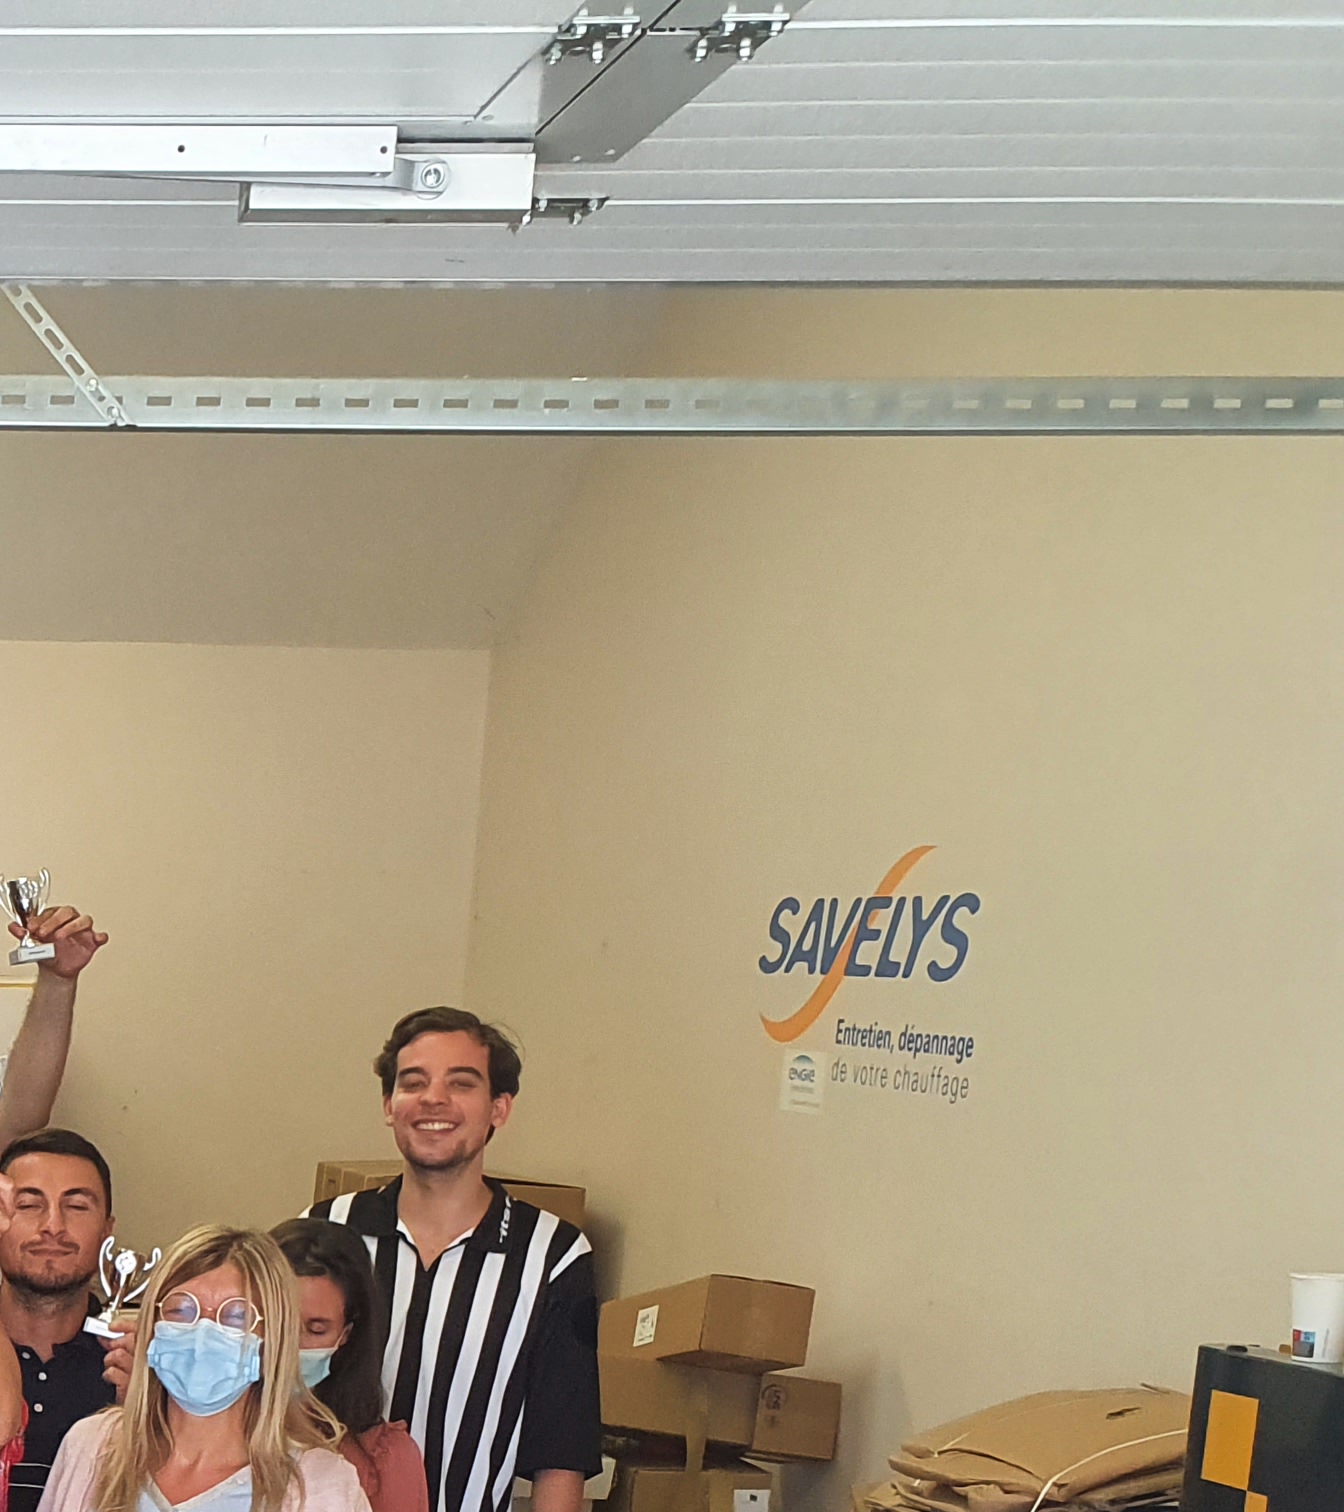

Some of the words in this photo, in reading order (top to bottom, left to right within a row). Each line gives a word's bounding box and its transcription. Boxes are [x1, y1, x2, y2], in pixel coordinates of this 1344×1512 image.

[758, 892, 981, 983] SAVELYS
[835, 1018, 895, 1054] Entretien,
[898, 1023, 975, 1065] dépannage
[831, 1056, 848, 1083] de
[853, 1062, 889, 1089] votre
[893, 1063, 970, 1105] chauffage
